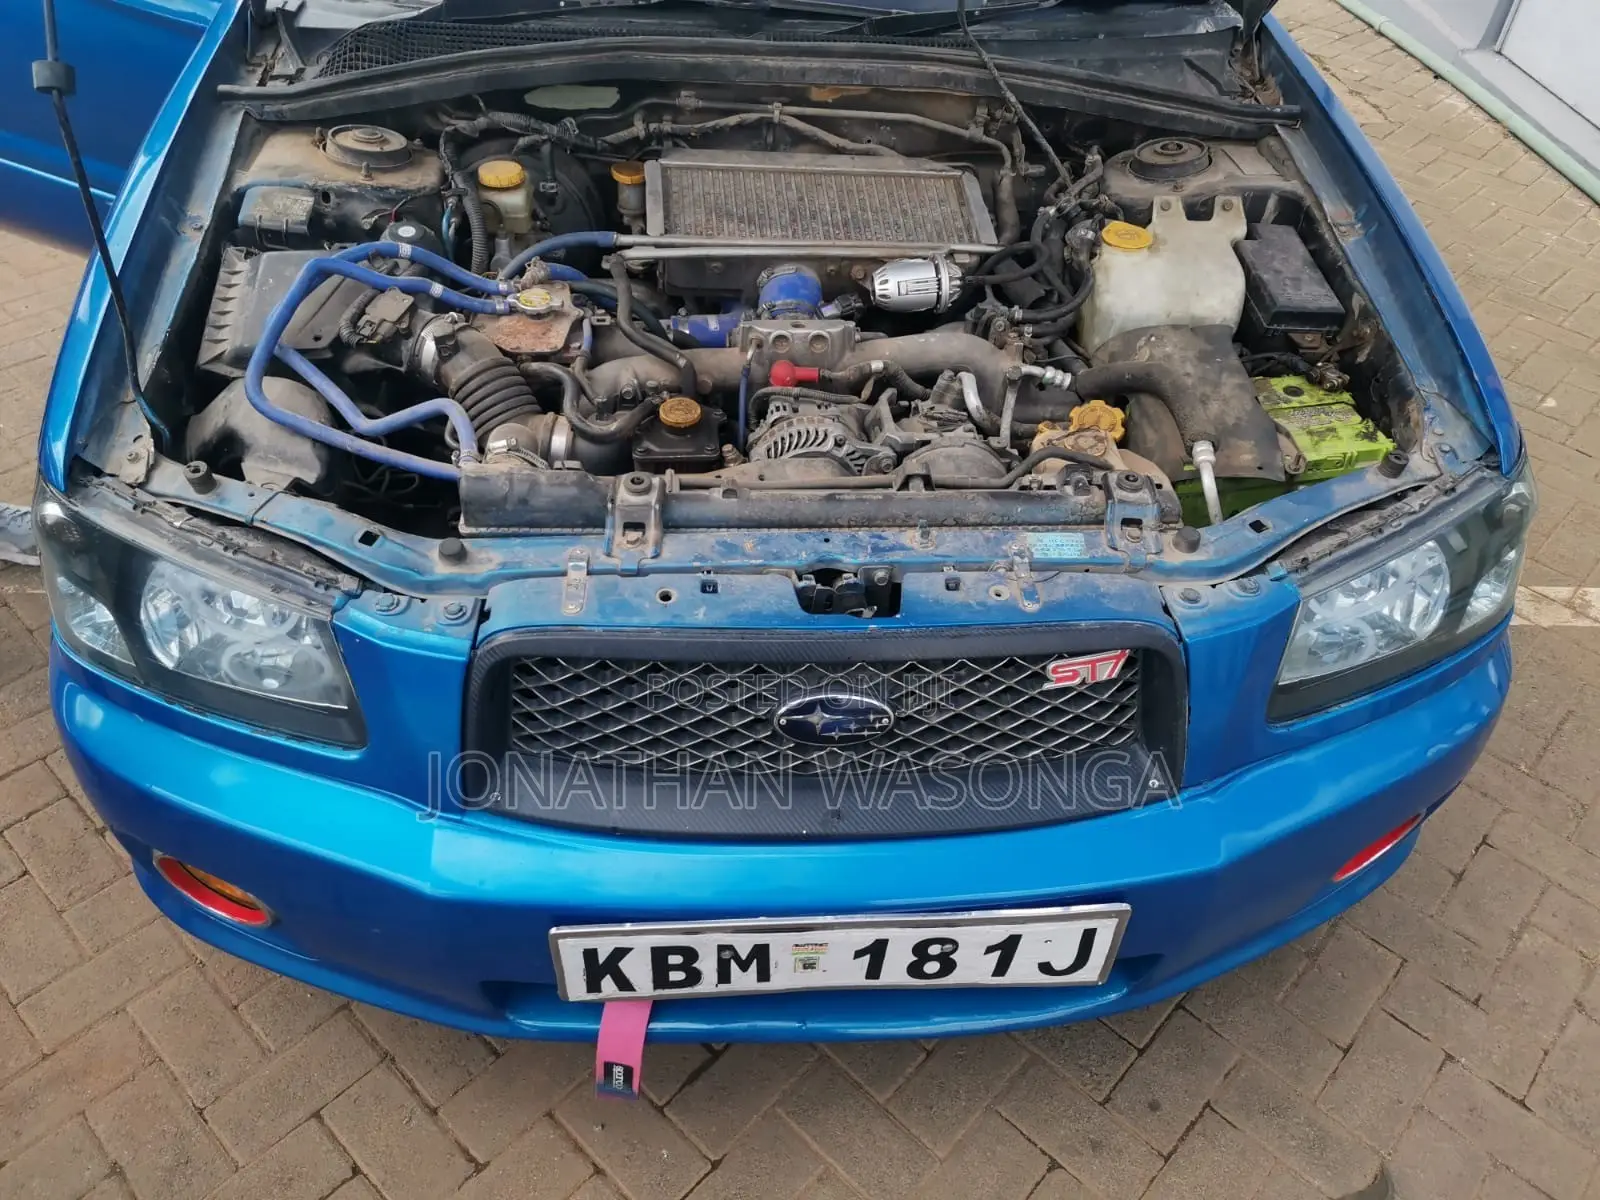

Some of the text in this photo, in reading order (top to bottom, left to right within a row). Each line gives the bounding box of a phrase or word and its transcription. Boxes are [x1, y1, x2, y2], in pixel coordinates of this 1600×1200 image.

[1042, 649, 1131, 690] STI
[582, 943, 771, 994] KBM
[853, 928, 1098, 980] 181J
